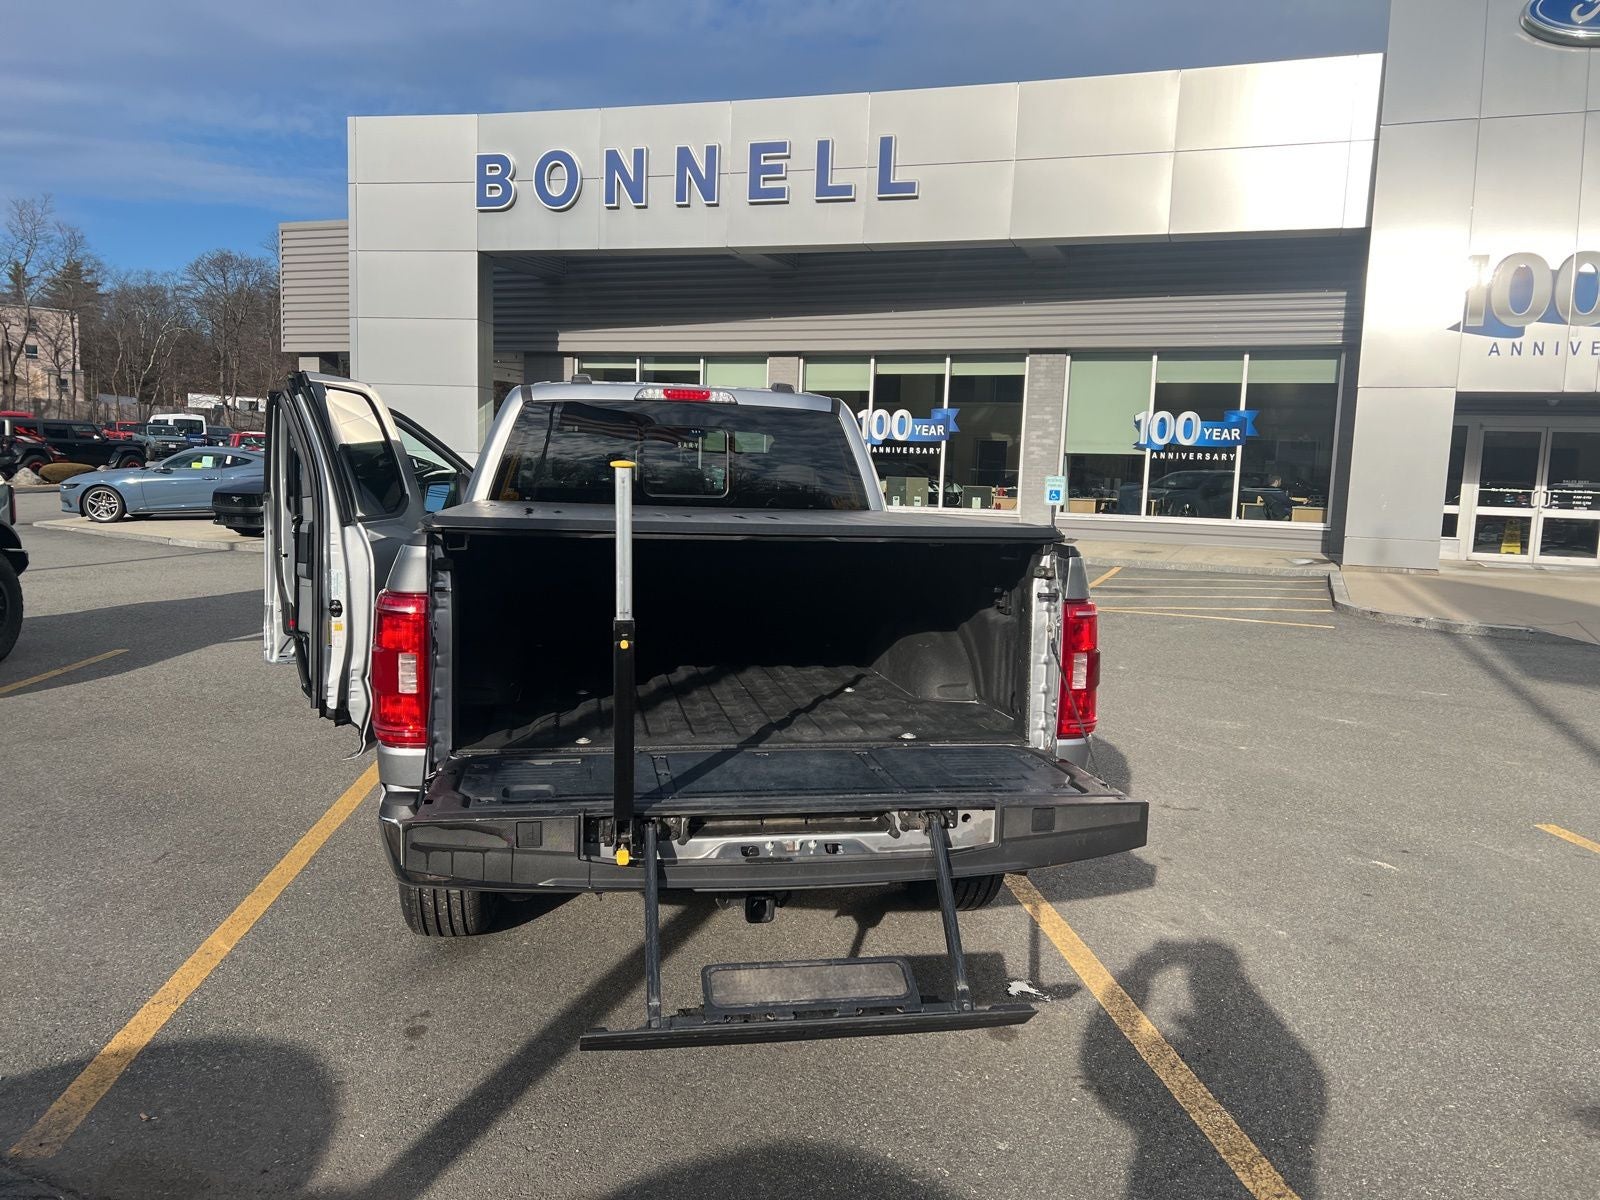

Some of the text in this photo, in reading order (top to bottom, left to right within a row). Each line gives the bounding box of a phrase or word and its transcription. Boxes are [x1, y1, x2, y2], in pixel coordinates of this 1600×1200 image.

[475, 135, 919, 212] BONNELL
[1465, 251, 1600, 328] 100
[857, 408, 945, 441] 100 YEAR
[1135, 410, 1241, 446] 100 YEAR
[871, 446, 941, 455] ANNIVERSARY
[1151, 451, 1236, 461] ANNIVERSARY
